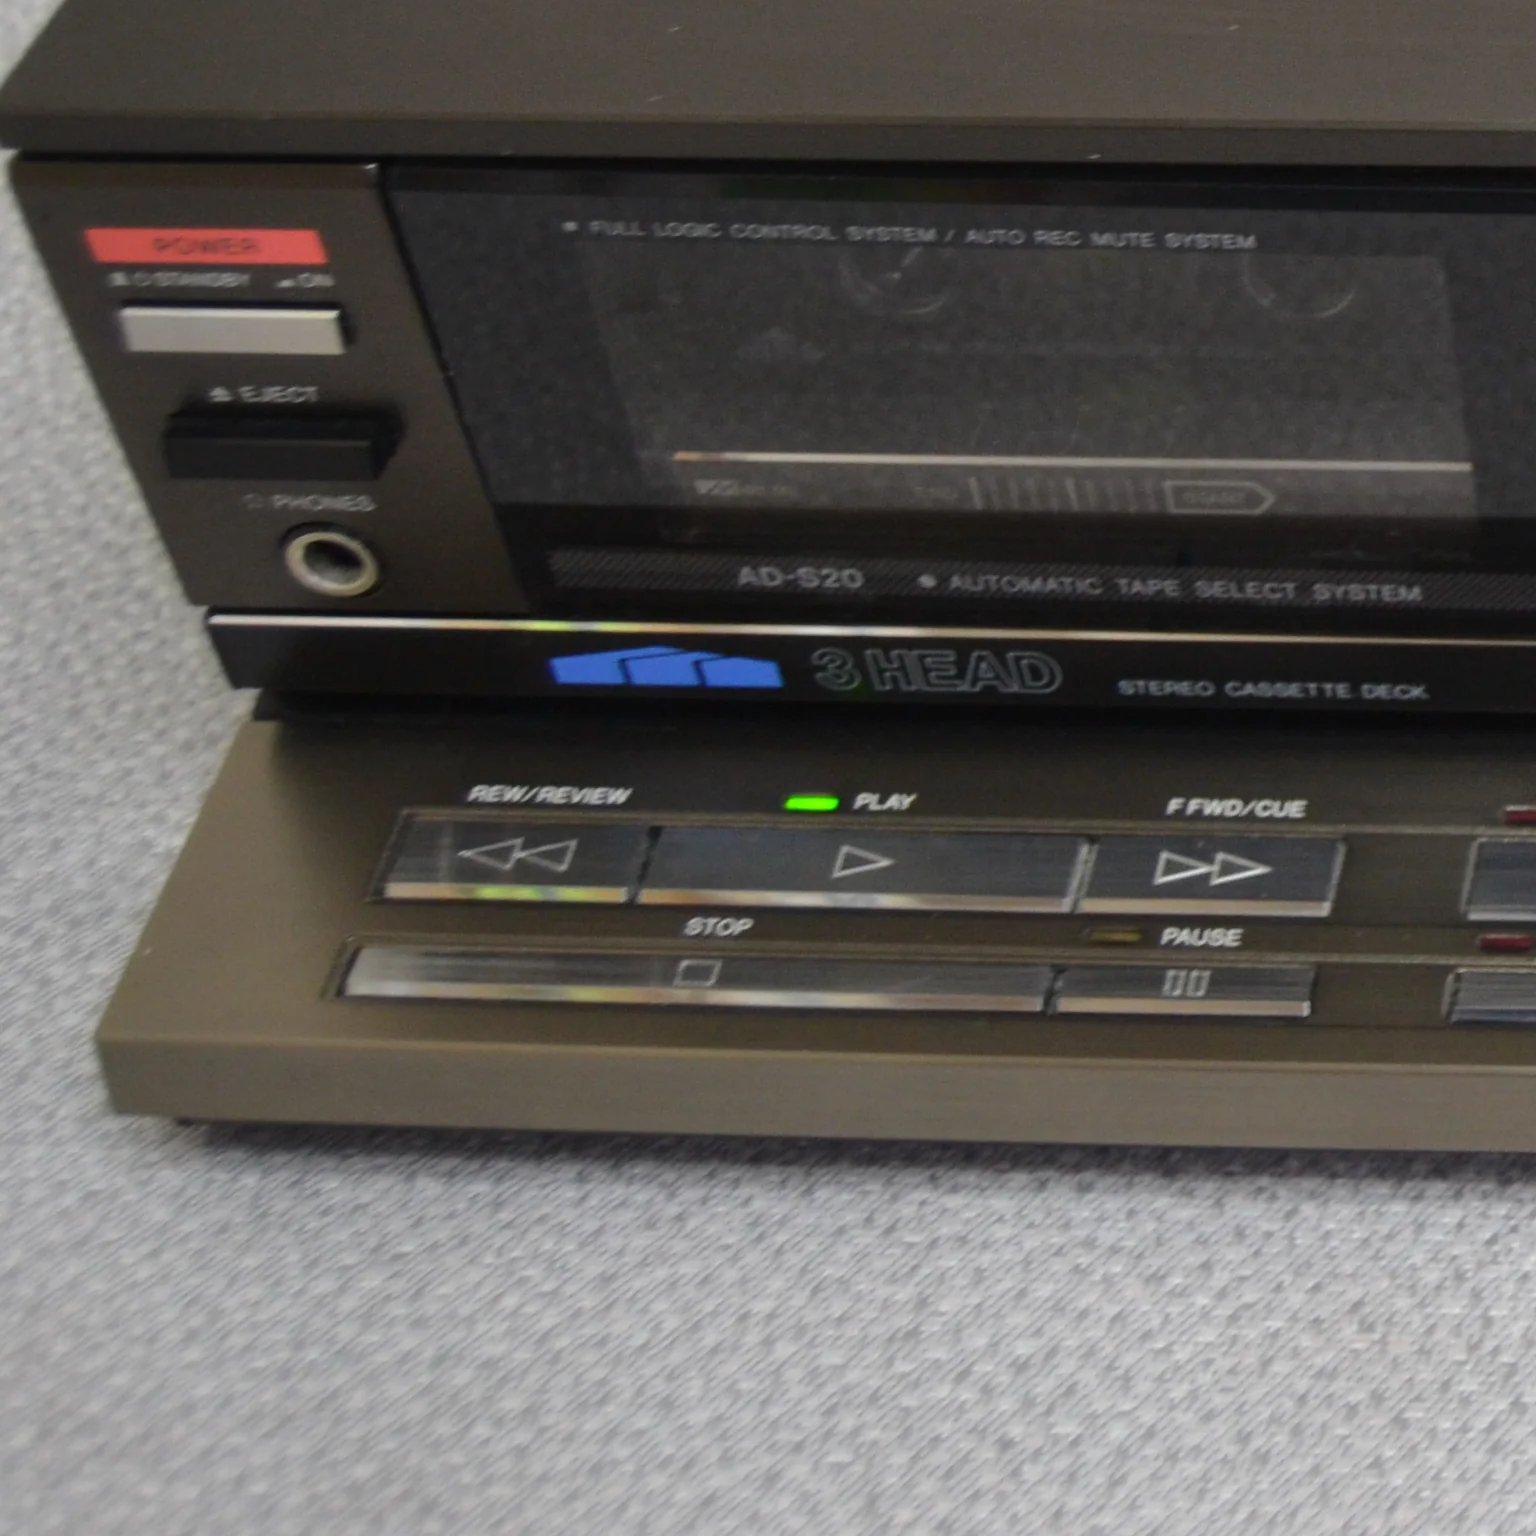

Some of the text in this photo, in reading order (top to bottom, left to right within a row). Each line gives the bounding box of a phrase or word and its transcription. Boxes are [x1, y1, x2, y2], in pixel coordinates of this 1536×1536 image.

[152, 237, 261, 256] POWER
[589, 220, 646, 236] FULL
[651, 222, 723, 239] LOGIC
[729, 223, 839, 242] CONTROL
[845, 225, 938, 244] SYSTEM
[964, 228, 1026, 247] AUTO
[1034, 230, 1081, 248] REC
[1090, 231, 1156, 250] MUTE
[1164, 232, 1257, 251] SYSTEM
[238, 385, 320, 404] EJECT
[271, 494, 378, 513] PHONES
[949, 573, 1103, 596] AUTOMATIC
[1116, 576, 1182, 598] TAPE
[1194, 579, 1298, 601] SELECT
[1313, 582, 1423, 604] SYSTEM
[811, 647, 1063, 696] 3 HEAD
[1117, 678, 1430, 701] STEREO CASSETTE DECK
[466, 784, 634, 806] REW/REVIEW
[851, 792, 919, 812] PLAY
[681, 915, 756, 937] STOP
[1160, 926, 1244, 949] PAUSE
